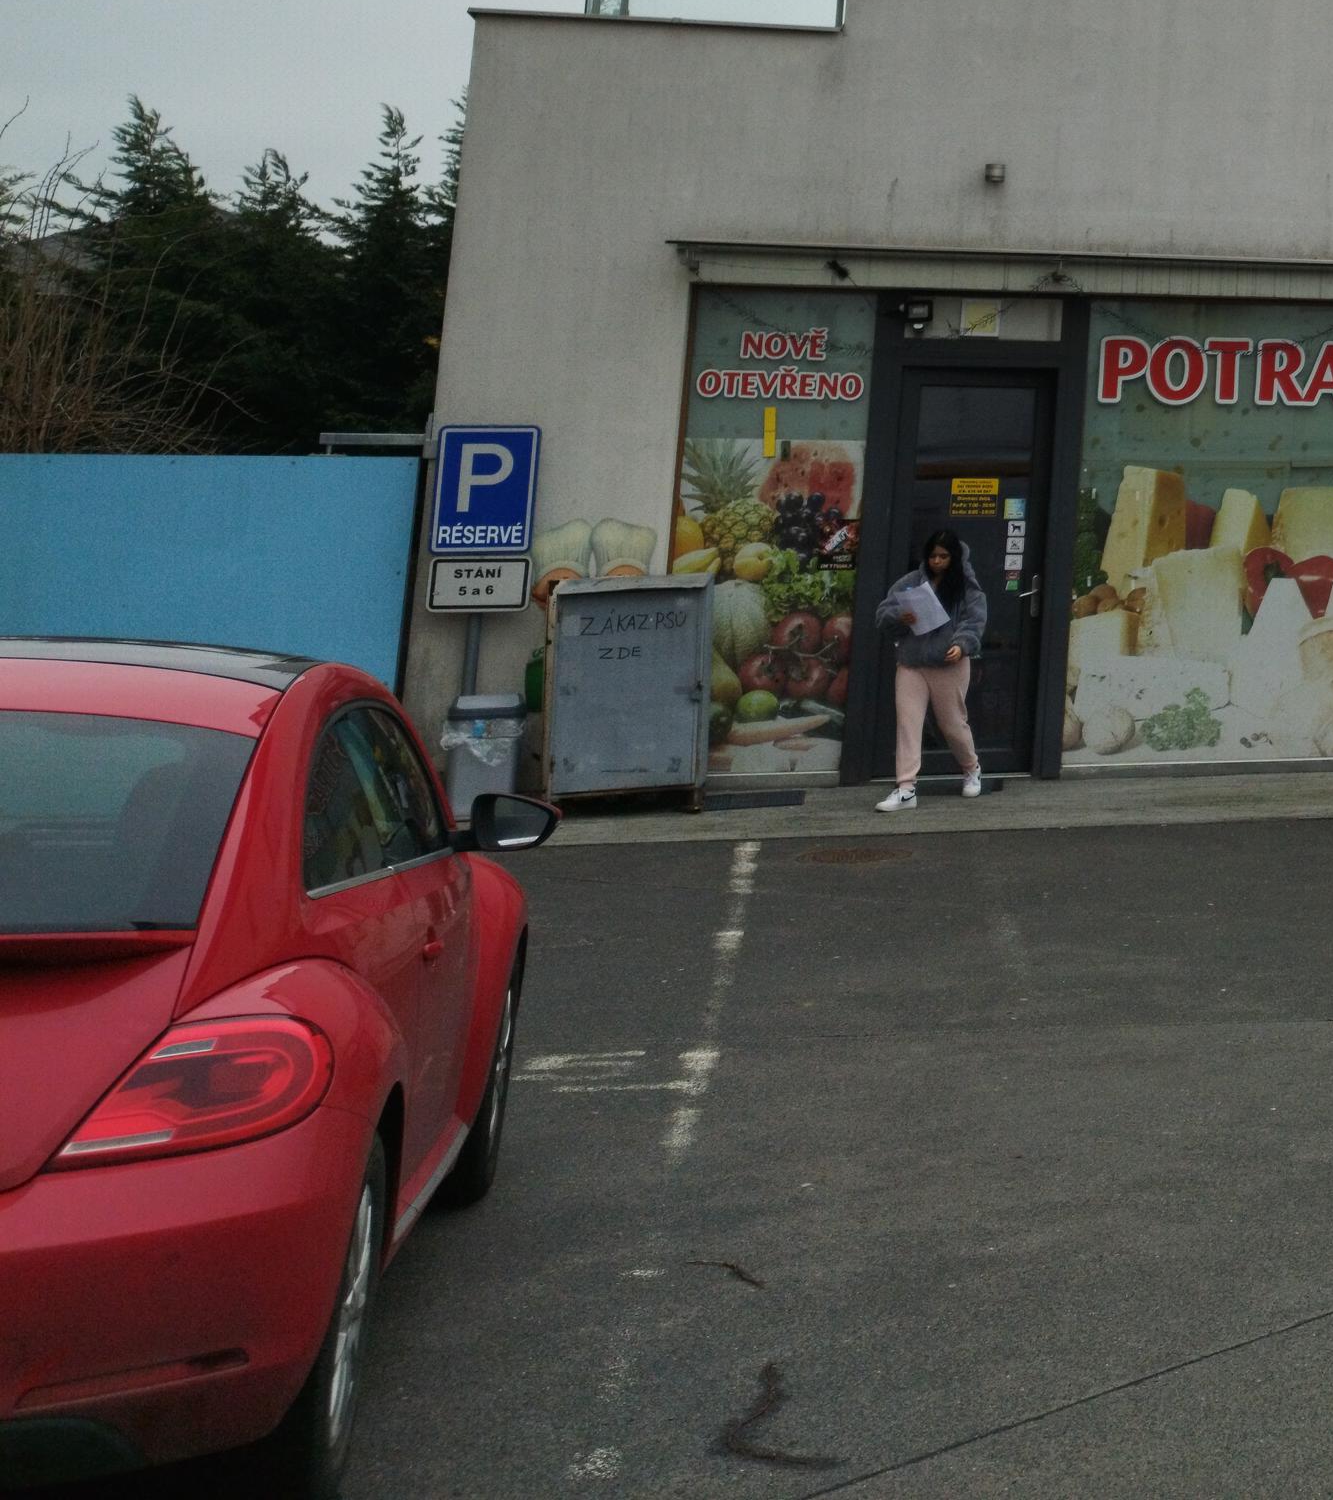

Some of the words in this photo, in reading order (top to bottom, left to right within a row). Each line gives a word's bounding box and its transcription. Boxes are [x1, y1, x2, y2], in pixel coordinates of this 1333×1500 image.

[696, 365, 864, 401] OTEVŘENO
[456, 443, 514, 513] P
[437, 522, 524, 545] RÉSERVÉ
[453, 565, 501, 579] STÁNÍ
[458, 586, 467, 596] 5
[471, 586, 481, 596] a
[485, 585, 494, 595] 6
[580, 608, 650, 636] ZÁKAZ
[598, 646, 642, 660] ZDE
